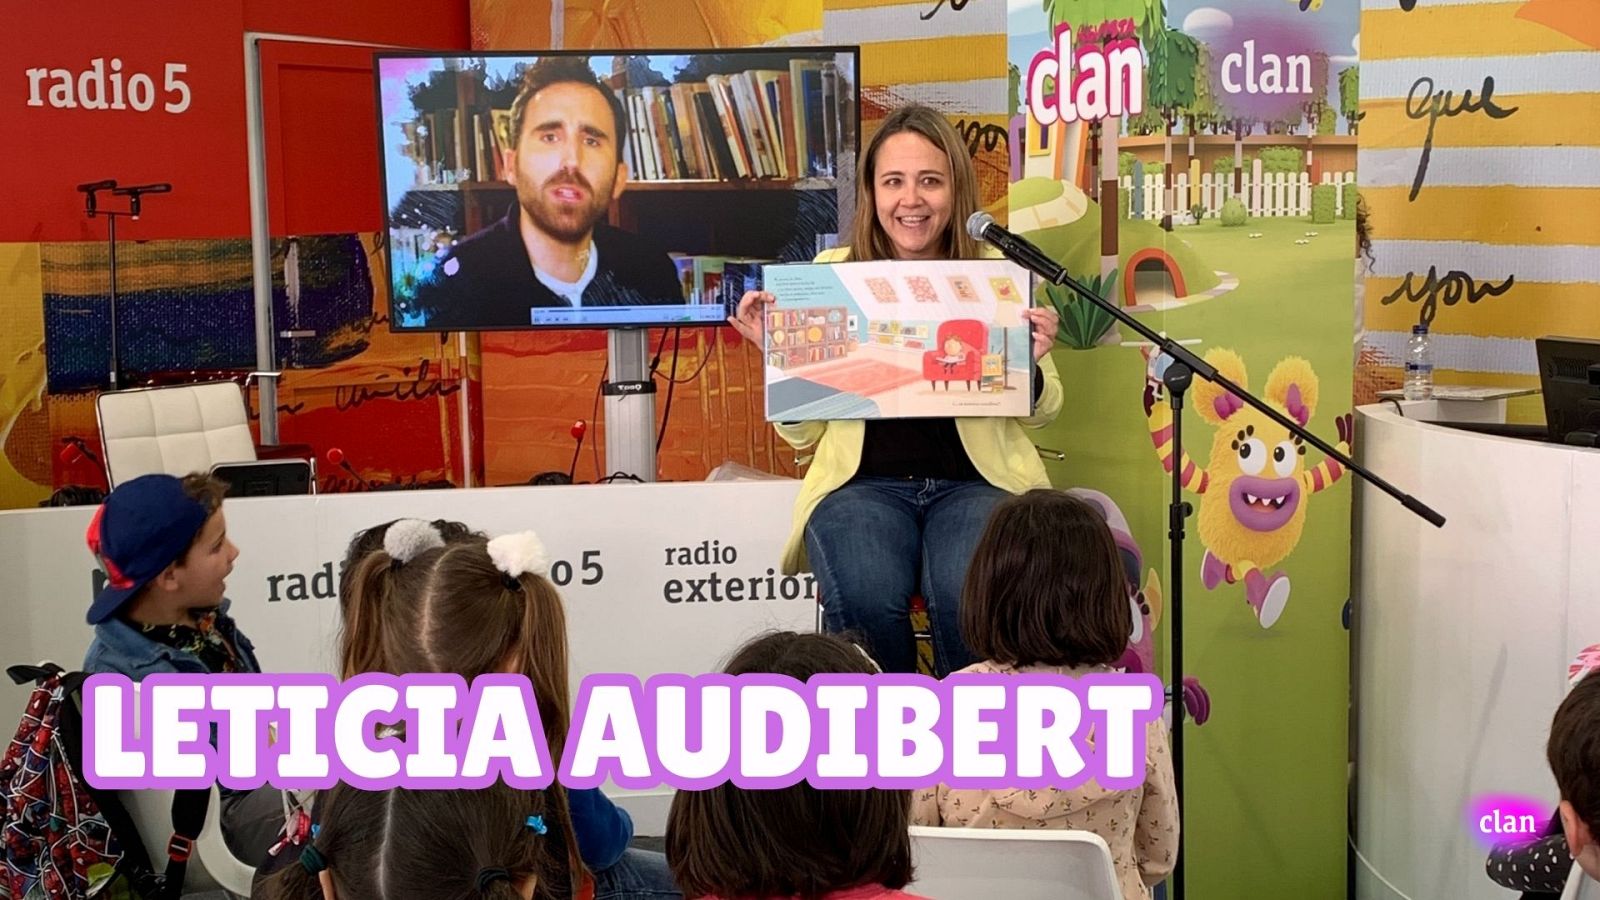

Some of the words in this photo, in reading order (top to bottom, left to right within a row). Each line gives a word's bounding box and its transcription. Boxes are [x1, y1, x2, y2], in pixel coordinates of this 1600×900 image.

[26, 57, 155, 112] radio
[164, 62, 191, 114] 5
[1029, 26, 1143, 125] clan
[1221, 40, 1313, 94] clan
[581, 550, 604, 585] 5
[665, 540, 738, 566] radio
[663, 567, 818, 604] exterior
